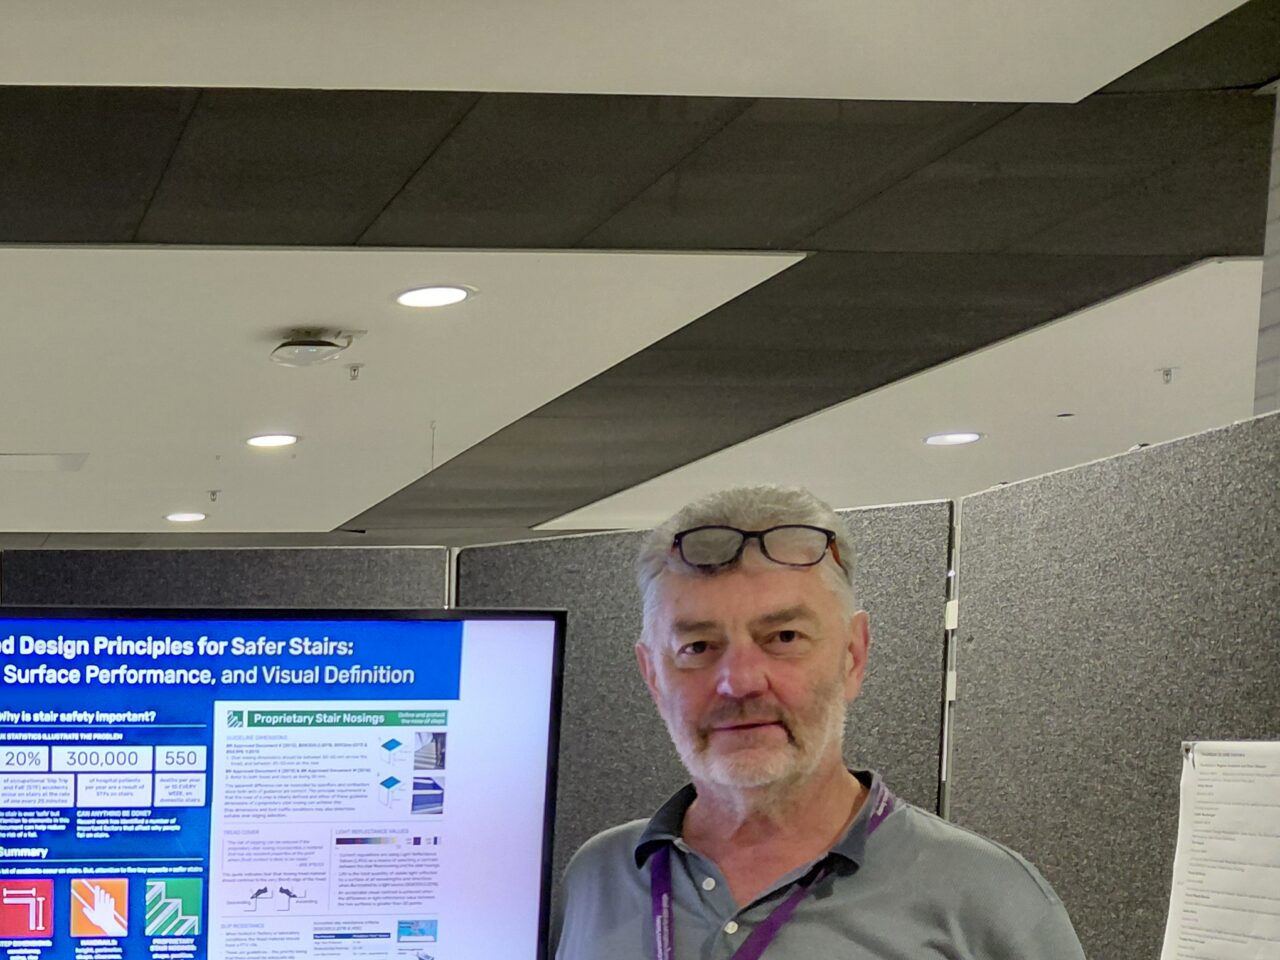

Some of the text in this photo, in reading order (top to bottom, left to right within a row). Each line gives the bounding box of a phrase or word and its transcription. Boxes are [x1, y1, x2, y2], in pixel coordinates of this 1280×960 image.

[19, 635, 90, 660] Design
[93, 635, 195, 660] Principles
[197, 636, 229, 656] for
[230, 636, 287, 656] Safer
[288, 636, 355, 656] Stairs:
[3, 664, 81, 684] Surface
[85, 664, 217, 686] Performance,
[220, 666, 258, 684] and
[261, 666, 320, 684] Visual
[323, 665, 415, 684] Definition
[21, 710, 32, 723] is
[33, 710, 59, 723] stair
[60, 710, 94, 724] safety
[96, 710, 157, 724] important?
[253, 712, 385, 726] Proprietary Stair Nosings
[5, 751, 41, 767] 20%
[66, 751, 139, 768] 300,000
[165, 751, 198, 766] 550
